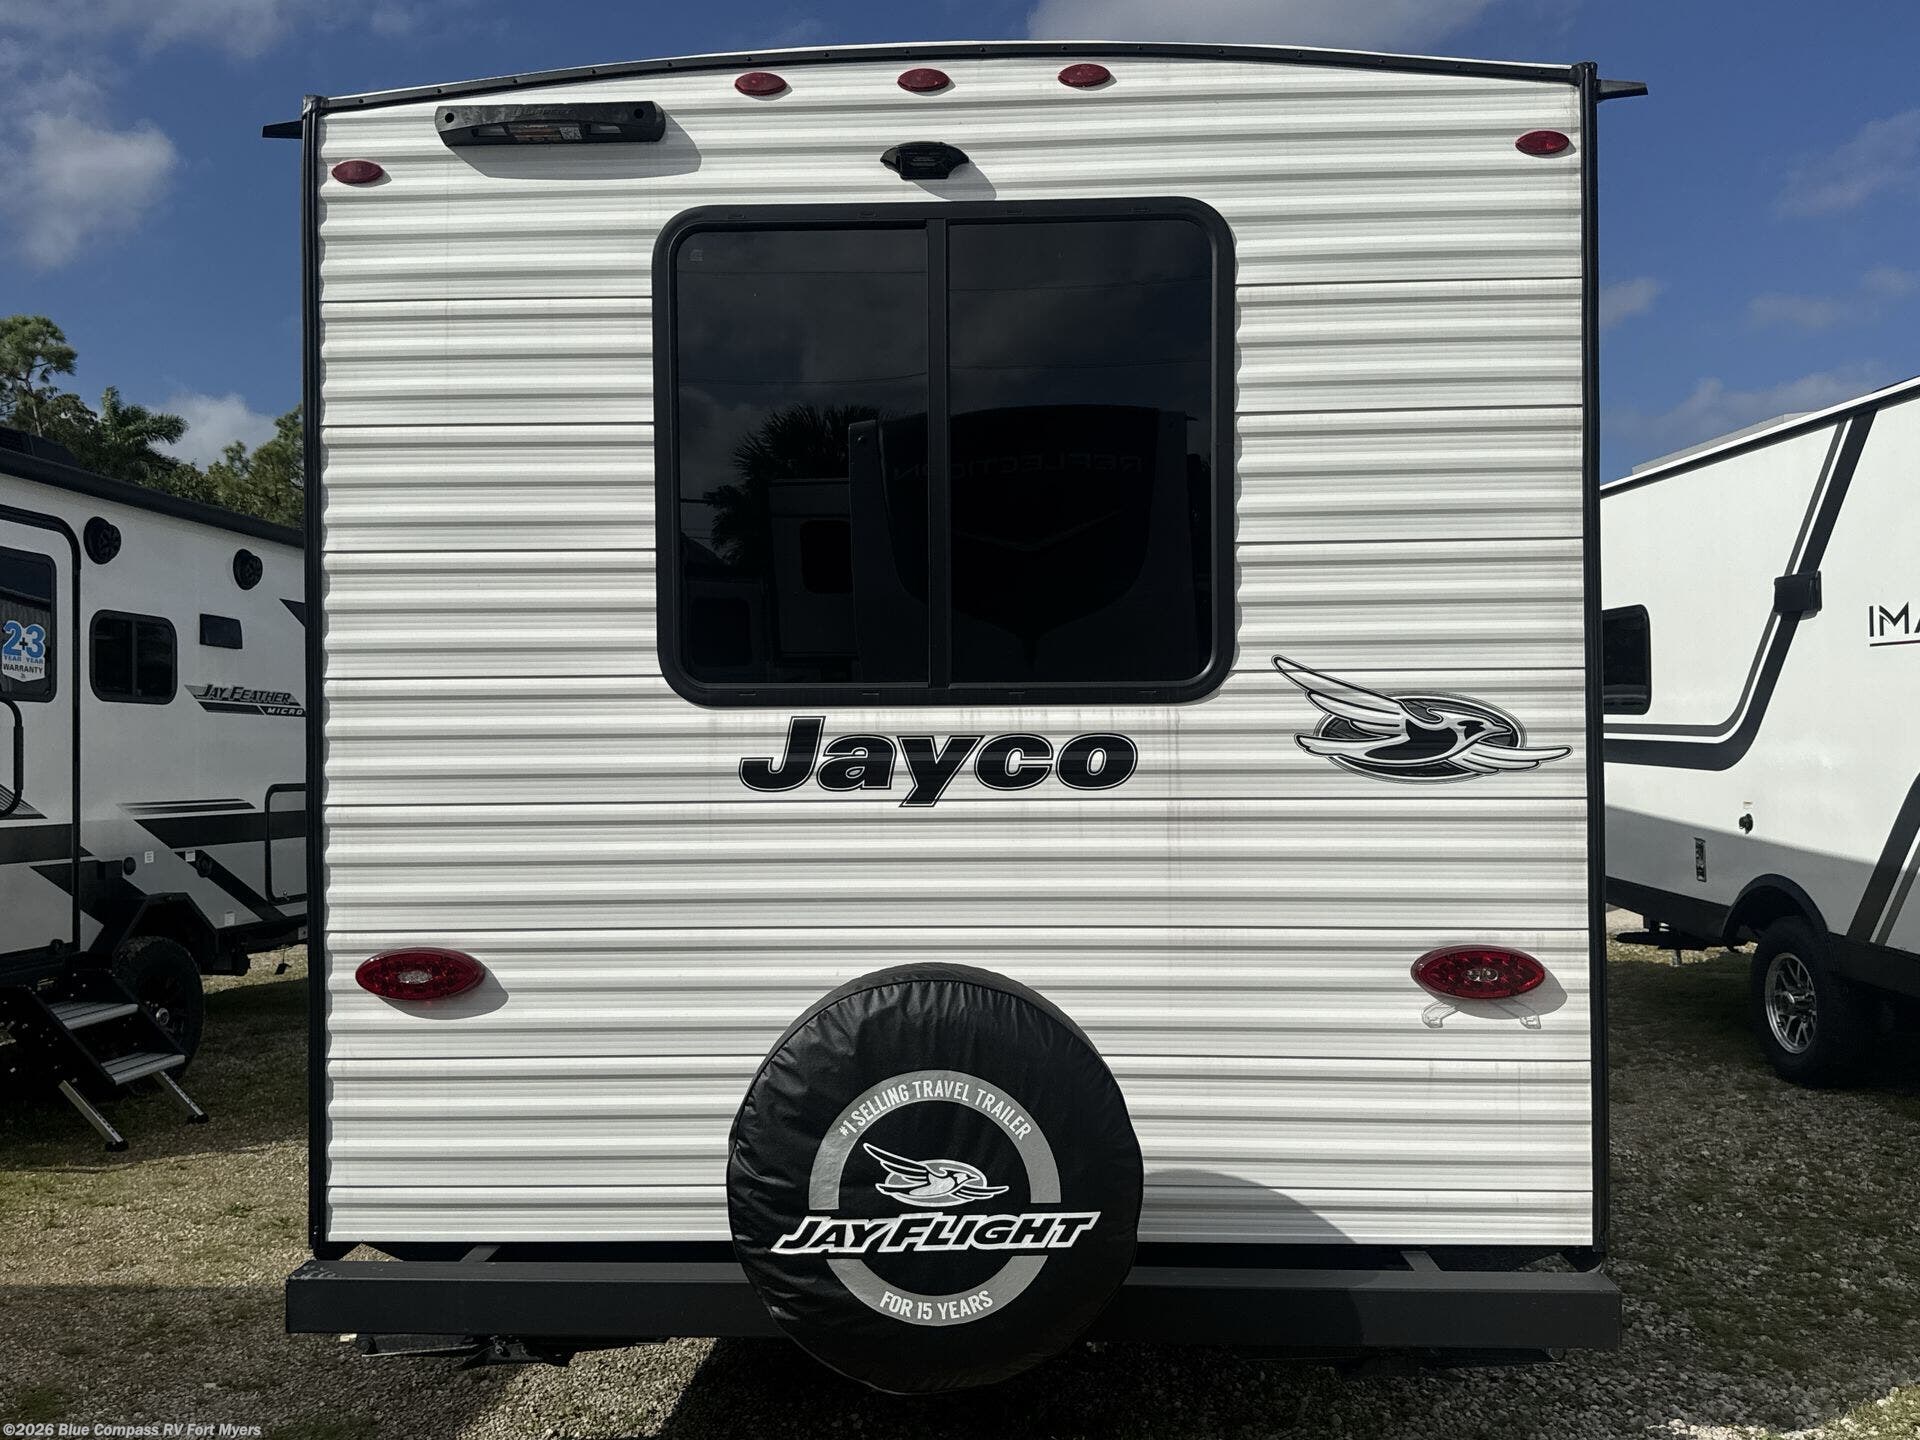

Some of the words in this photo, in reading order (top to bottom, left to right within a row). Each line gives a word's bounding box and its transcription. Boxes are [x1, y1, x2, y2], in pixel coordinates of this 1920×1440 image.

[1869, 601, 1920, 637] IM
[3, 663, 43, 674] WARRANTY
[227, 686, 292, 704] FEATHER
[267, 708, 304, 716] MICRO
[739, 716, 1138, 807] Jayco
[838, 1119, 858, 1137] #1
[850, 1084, 910, 1127] SELLING
[912, 1079, 969, 1102] TRAVEL
[977, 1088, 1032, 1141] TRAILER
[879, 1290, 912, 1317] FOR
[917, 1301, 932, 1320] 15
[939, 1289, 994, 1320] YEARS
